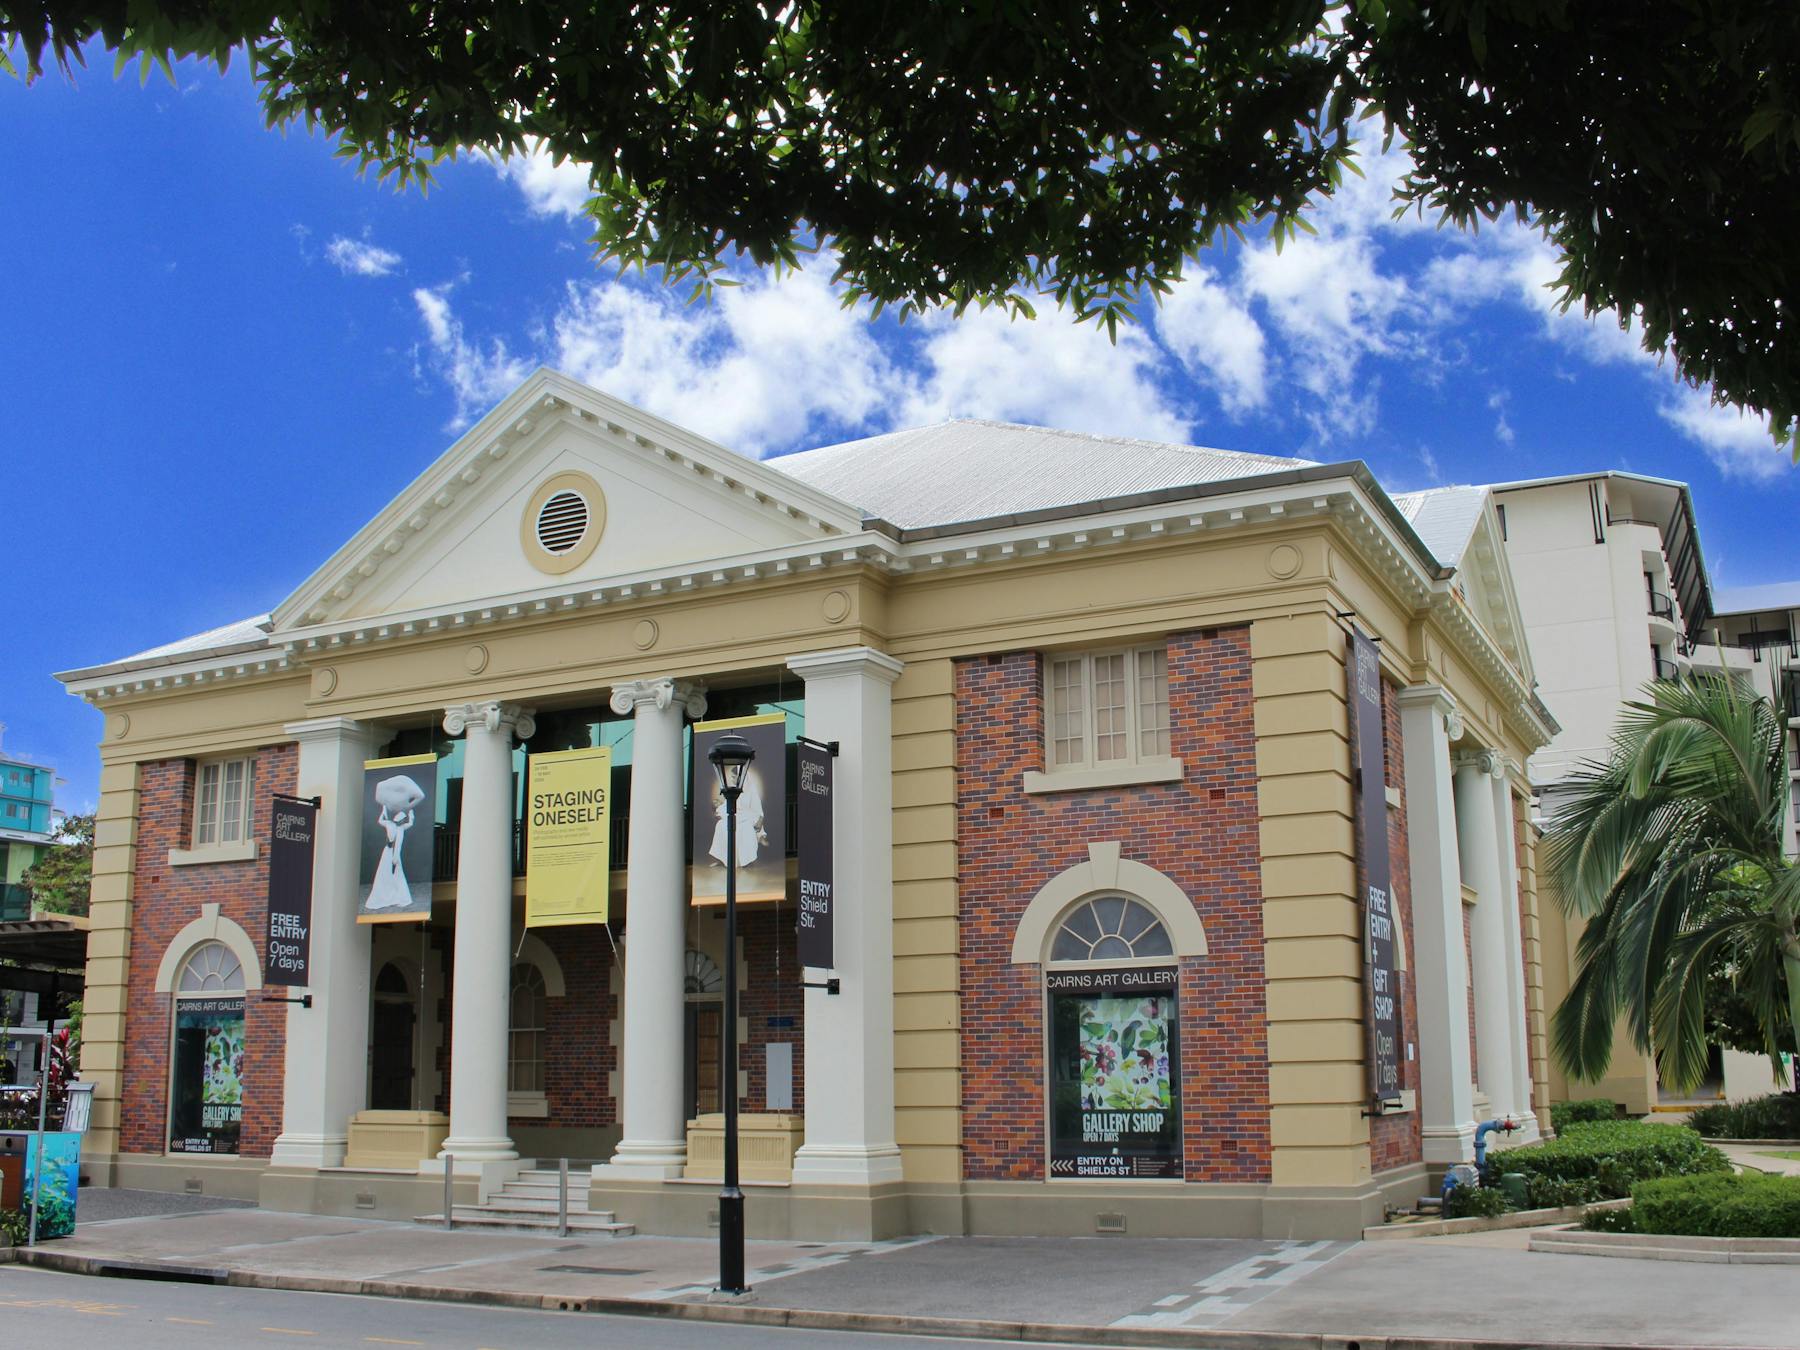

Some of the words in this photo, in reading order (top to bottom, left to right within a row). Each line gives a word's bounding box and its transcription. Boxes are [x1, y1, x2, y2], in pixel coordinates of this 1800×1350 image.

[801, 760, 825, 776] CAIRNS
[801, 769, 813, 782] ART
[801, 780, 829, 796] GALLERY
[534, 788, 605, 809] STAGING
[276, 812, 306, 826] CAIRNS
[533, 806, 605, 827] ONESELF
[276, 821, 291, 831] ART
[275, 829, 312, 842] GALLERY
[800, 879, 831, 898] ENTRY
[800, 895, 828, 914] Shield
[1369, 886, 1387, 914] FREE
[271, 912, 301, 927] FREE
[800, 911, 816, 928] Str.
[1371, 913, 1391, 942] ENTRY
[270, 925, 307, 940] ENTRY
[269, 940, 300, 957] Open
[269, 954, 277, 968] 7
[278, 955, 305, 972] days
[1047, 975, 1092, 988] CAIRNS
[1094, 973, 1119, 986] ART
[1121, 971, 1178, 985] GALLERY
[1373, 967, 1389, 993] GIFT
[176, 1002, 202, 1012] CAIRNS
[203, 1001, 217, 1011] ART
[218, 1001, 245, 1011] GALLER
[1375, 995, 1393, 1021] SHOP
[1376, 1030, 1393, 1061] Open
[1377, 1059, 1382, 1085] 7
[1382, 1058, 1398, 1091] days
[203, 1105, 230, 1121] GALLERY
[1082, 1113, 1130, 1133] GALLERY
[1132, 1113, 1164, 1133] SHOP
[1082, 1131, 1100, 1142] OPEN
[1103, 1131, 1120, 1142] DAYS
[1077, 1156, 1107, 1166] ENTRY
[1108, 1156, 1124, 1166] ON
[1077, 1166, 1117, 1176] SHIELDS
[1118, 1166, 1131, 1176] ST
